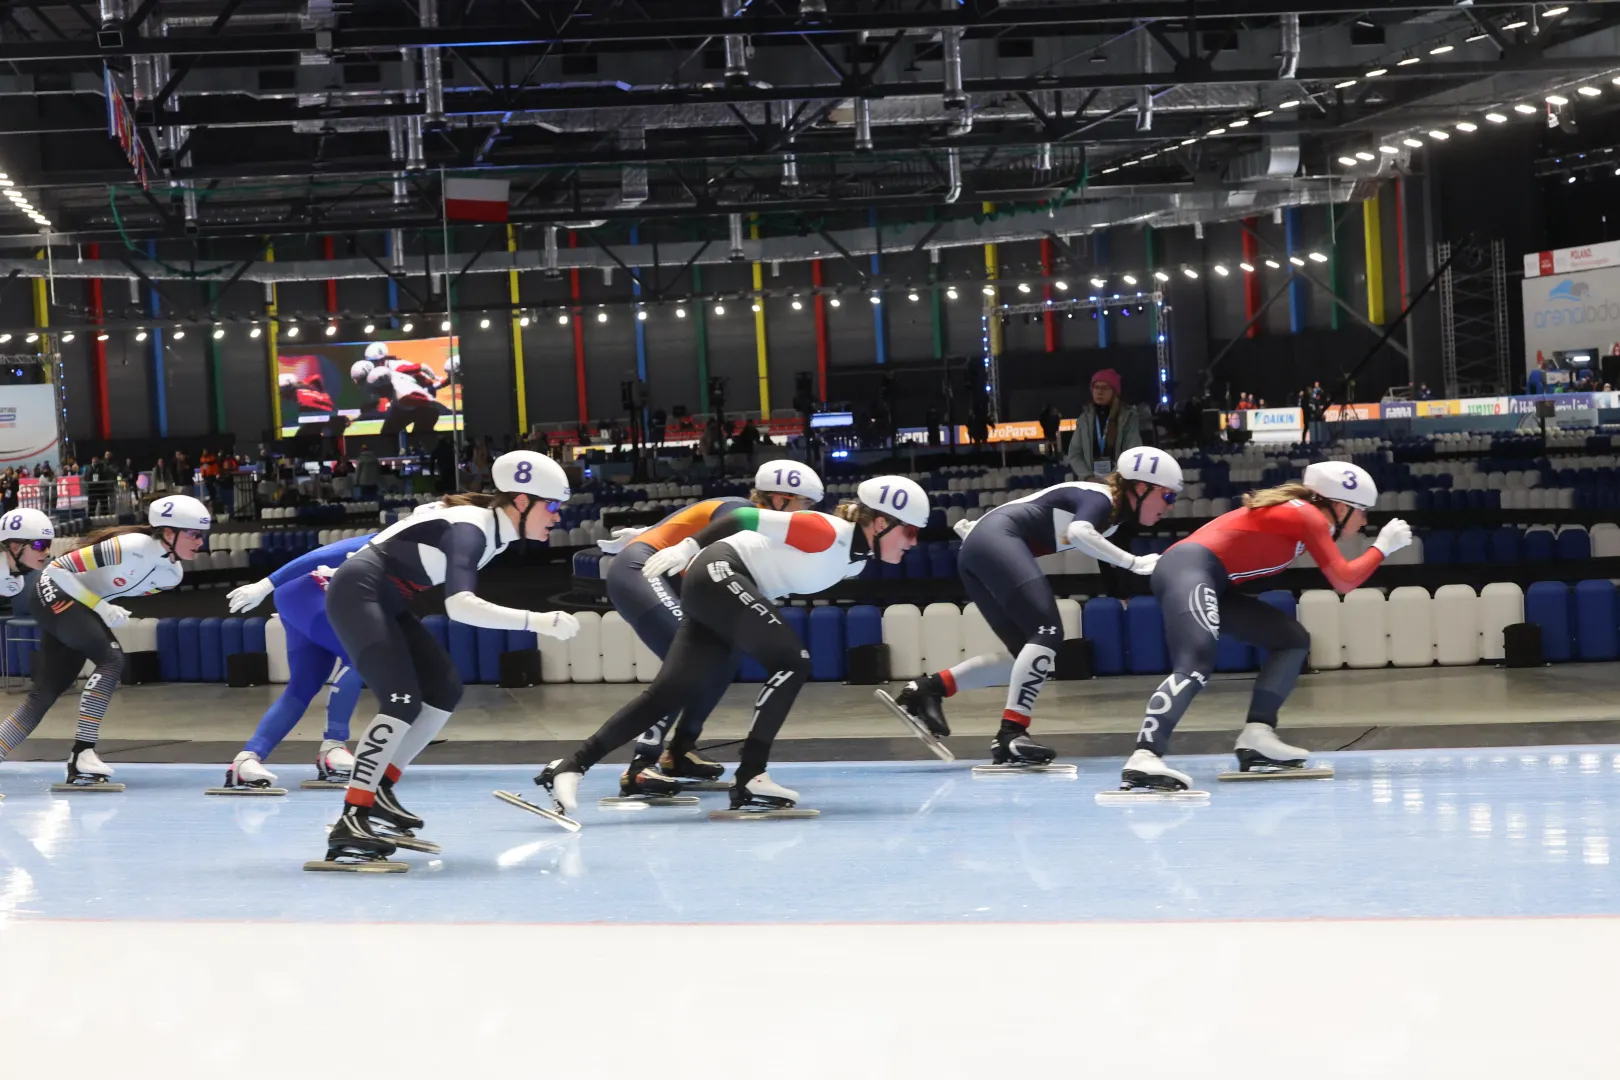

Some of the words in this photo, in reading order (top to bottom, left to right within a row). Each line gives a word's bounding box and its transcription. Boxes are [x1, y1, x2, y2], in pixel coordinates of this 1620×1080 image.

[1262, 413, 1295, 424] DAIKIN
[514, 461, 533, 484] 8
[1133, 452, 1160, 475] 11
[773, 468, 801, 488] 16
[1341, 470, 1358, 490] 3
[161, 501, 174, 518] 2
[878, 485, 908, 511] 10
[2, 514, 23, 531] 18
[648, 577, 685, 622] Staatslo
[727, 581, 783, 625] SEAT
[1017, 654, 1051, 711] CZE
[1137, 673, 1192, 743] NOR
[351, 723, 394, 785] CZE
